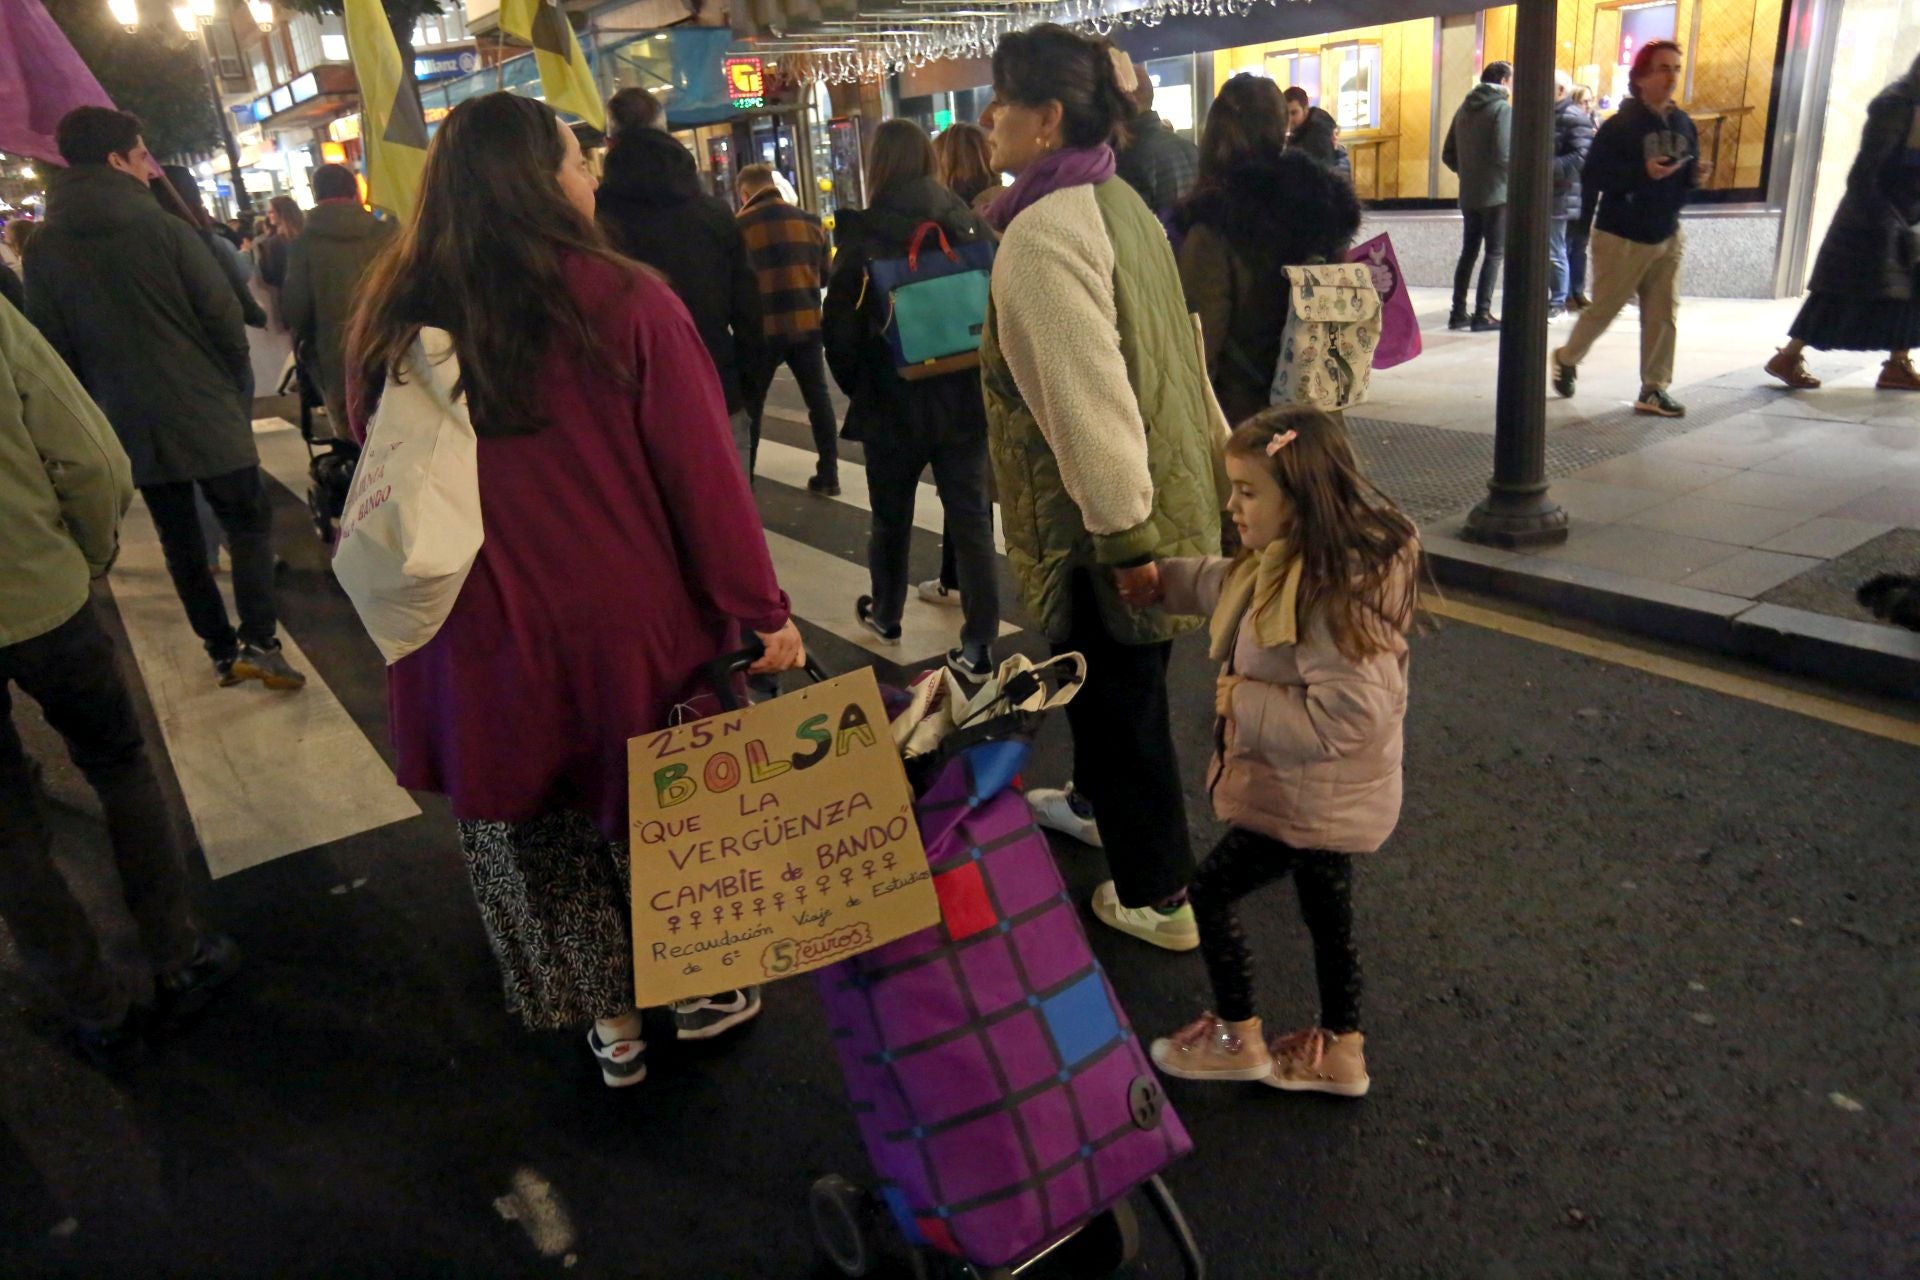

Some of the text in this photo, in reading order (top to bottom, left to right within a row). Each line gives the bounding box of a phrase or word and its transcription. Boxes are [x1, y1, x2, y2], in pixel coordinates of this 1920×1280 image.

[654, 703, 876, 809] BOLSA
[668, 792, 872, 870] VERGÜENZA
[740, 793, 780, 816] LA
[650, 868, 764, 911] CAMBIE
[781, 862, 803, 882] de
[652, 869, 931, 962] Recaudación Viaje de Estudios
[682, 962, 703, 976] de
[771, 941, 793, 973] 5
[802, 928, 864, 959] euros
